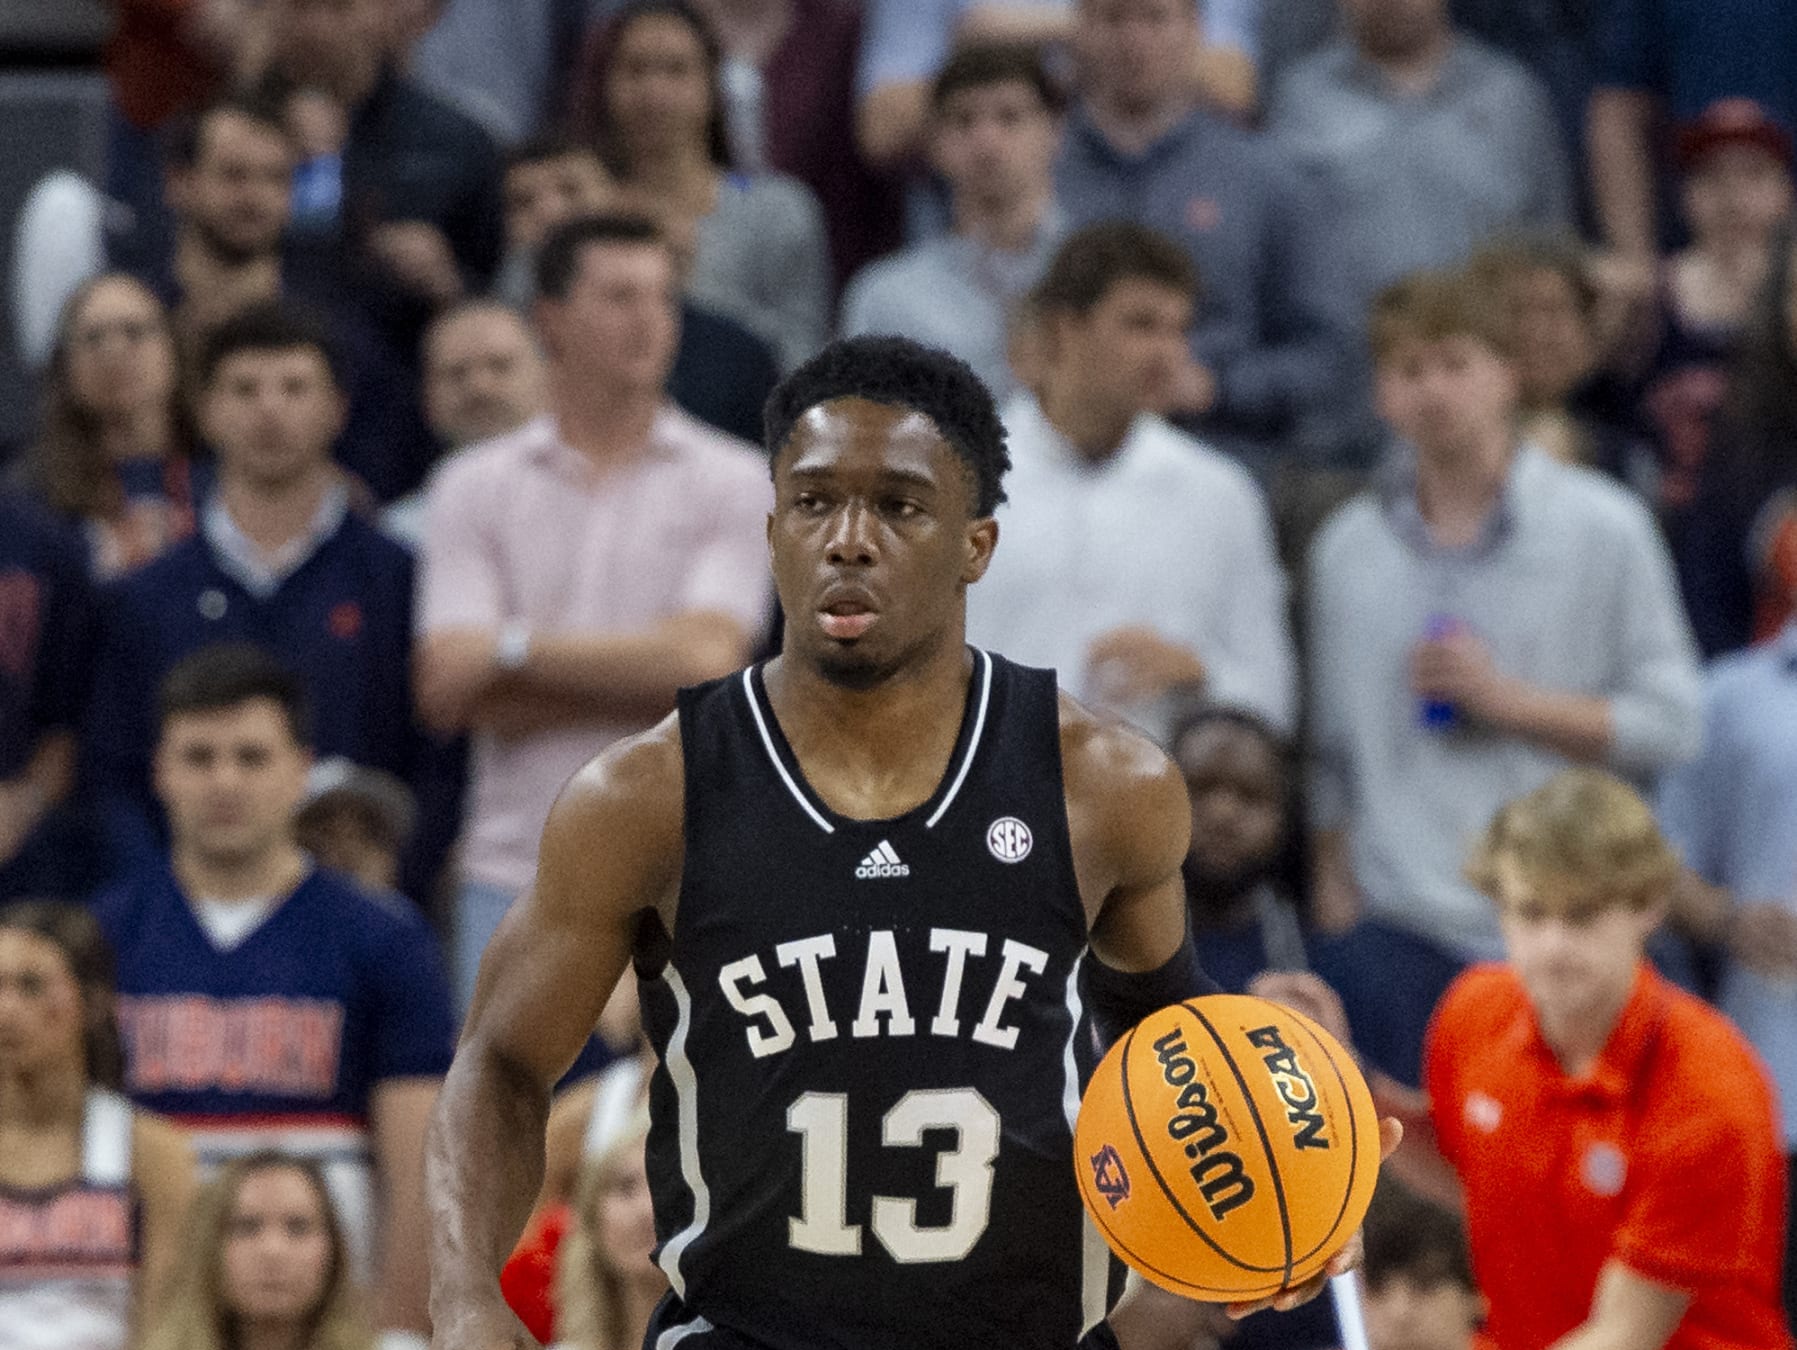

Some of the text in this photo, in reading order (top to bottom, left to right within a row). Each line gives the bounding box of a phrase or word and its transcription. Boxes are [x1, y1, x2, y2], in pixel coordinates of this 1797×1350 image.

[855, 864, 910, 878] adidas
[990, 819, 1031, 860] SEC
[718, 927, 1049, 1059] STATE
[1152, 1027, 1256, 1222] Wilson
[1246, 1025, 1330, 1150] NCAA
[786, 1087, 1001, 1264] 13
